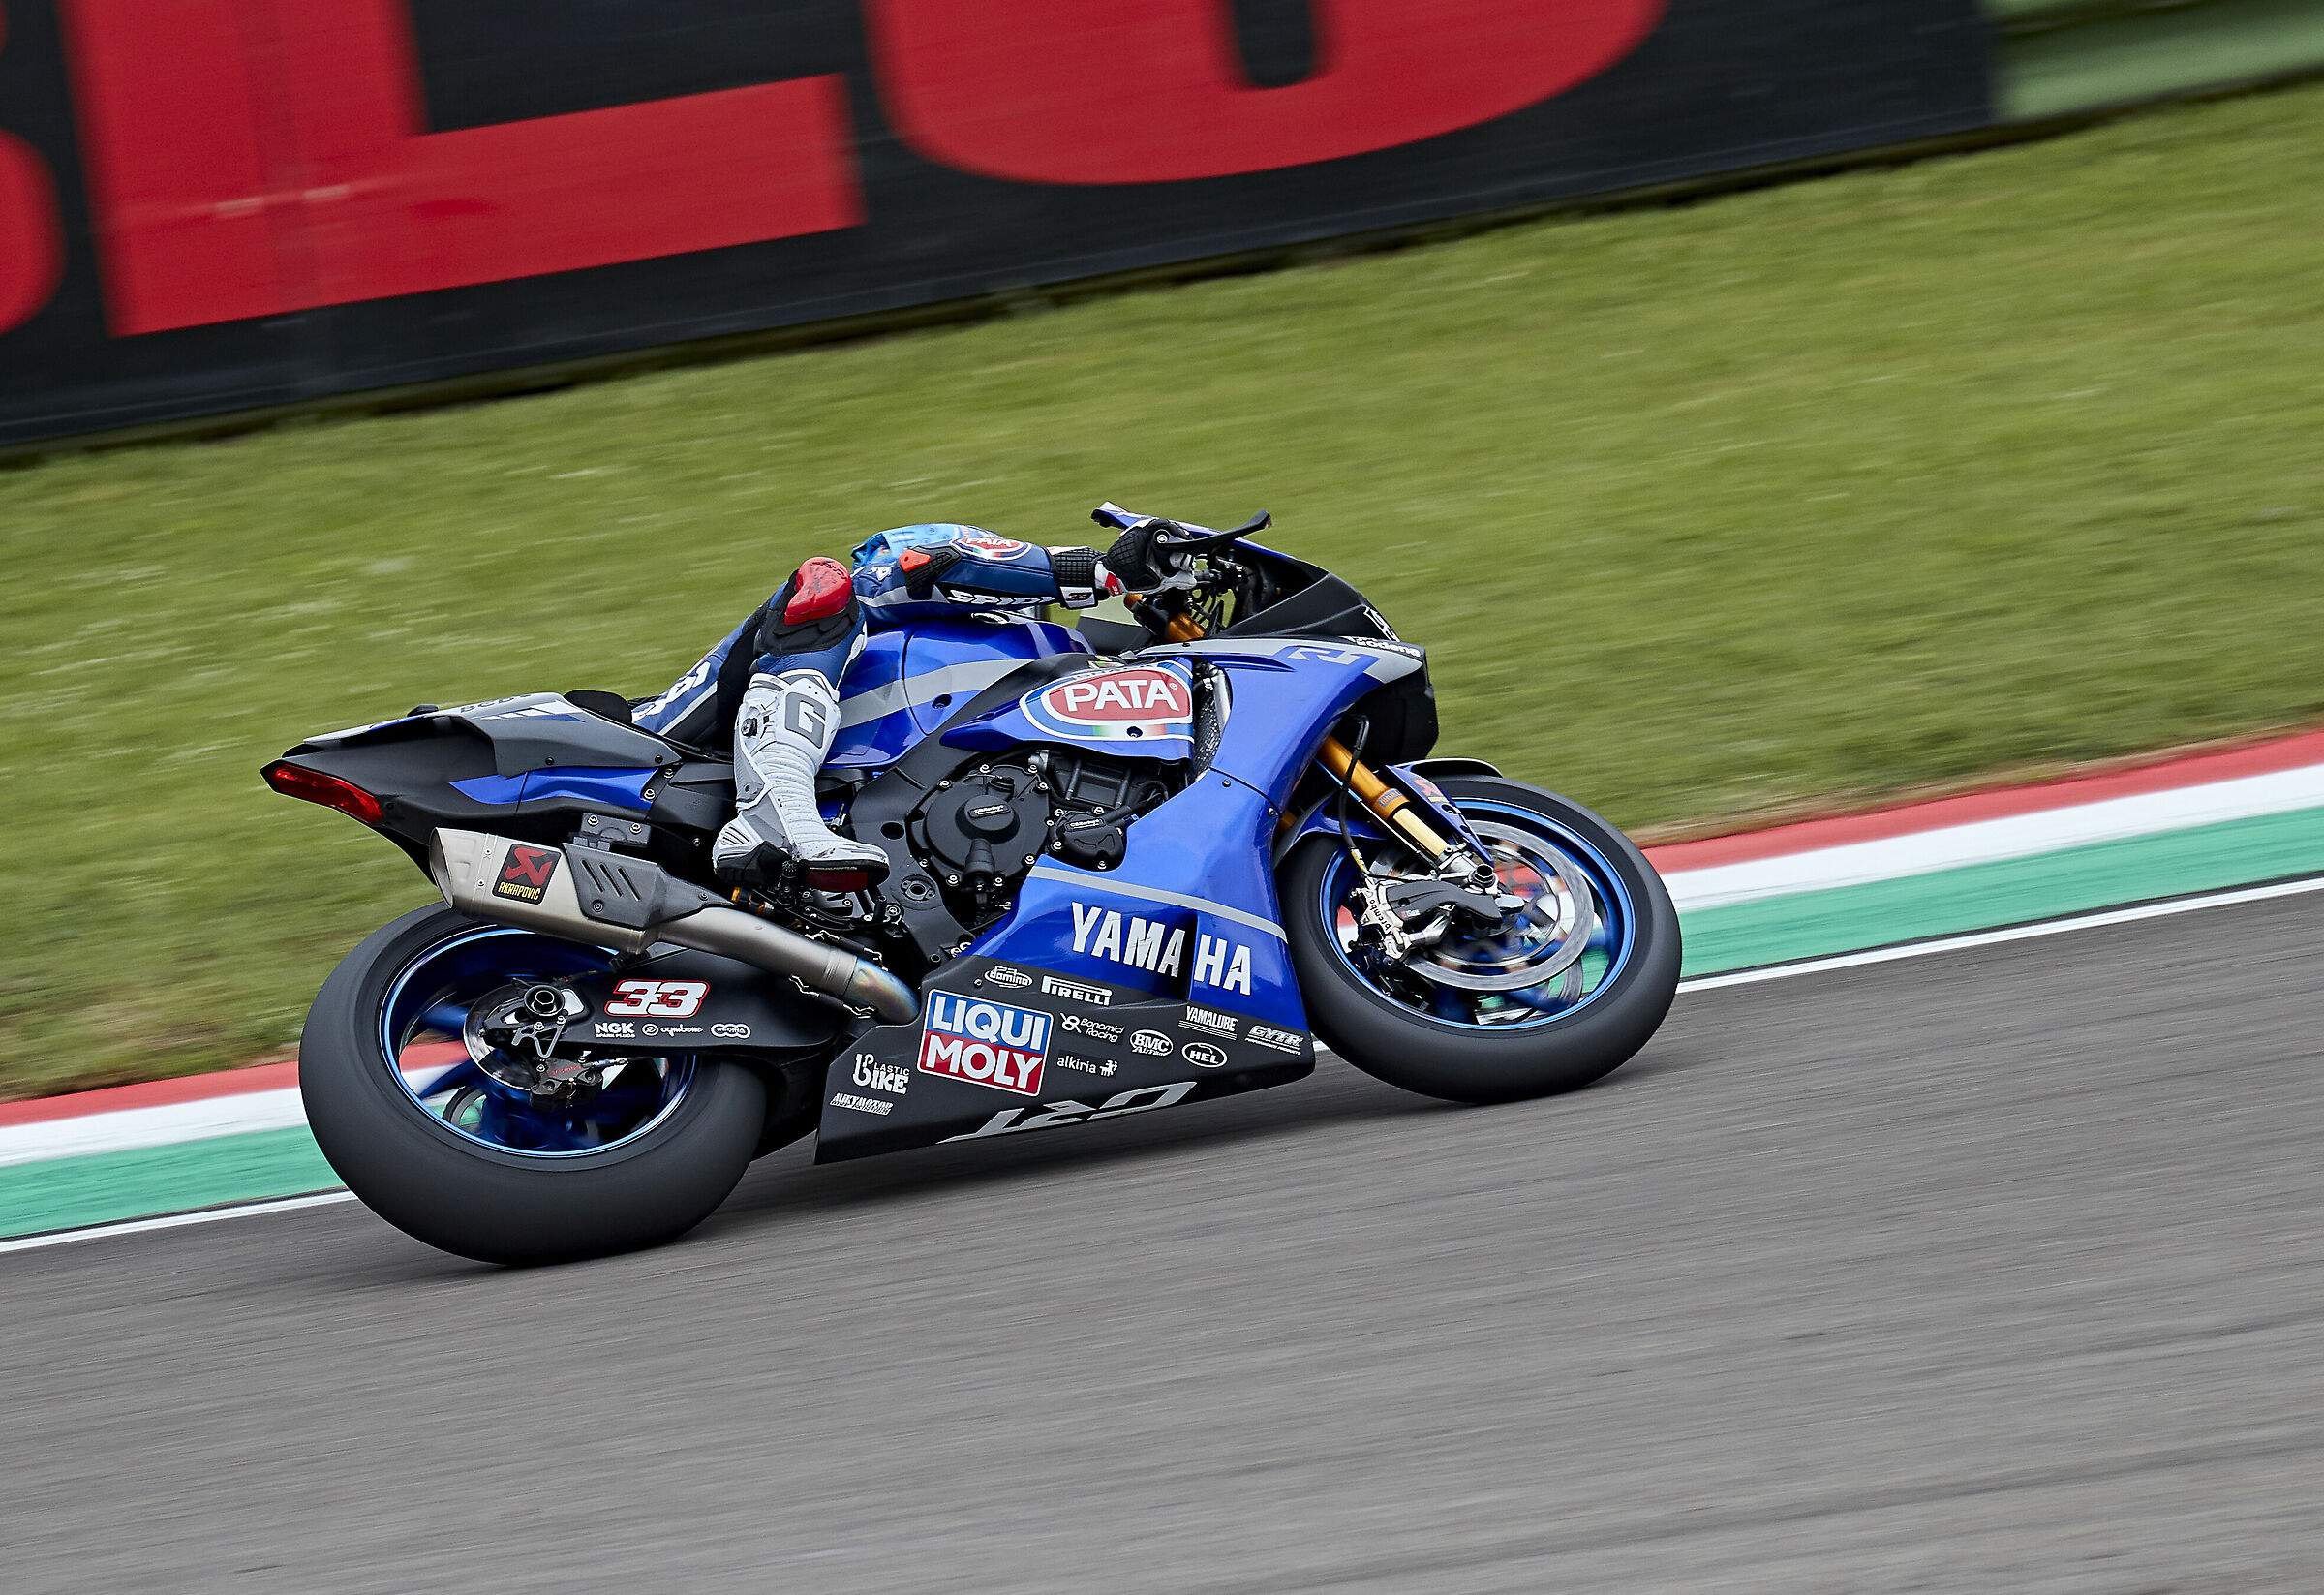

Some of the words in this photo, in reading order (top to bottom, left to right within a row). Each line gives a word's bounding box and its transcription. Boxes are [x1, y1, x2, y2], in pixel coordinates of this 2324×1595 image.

[945, 589, 1055, 605] SPIDI
[1063, 679, 1180, 712] PATA
[785, 691, 827, 749] G
[1368, 899, 1392, 932] brembo
[604, 978, 711, 1018] 33
[1040, 975, 1114, 1007] PIRELLI
[594, 1022, 635, 1034] NGK
[932, 995, 1047, 1051] LIQUI
[1185, 1005, 1239, 1032] YAMALUBE
[1134, 1033, 1169, 1052] BMC
[1189, 1049, 1219, 1065] HEL
[925, 1034, 1043, 1089] MOLY
[1056, 1055, 1097, 1074] alkiria
